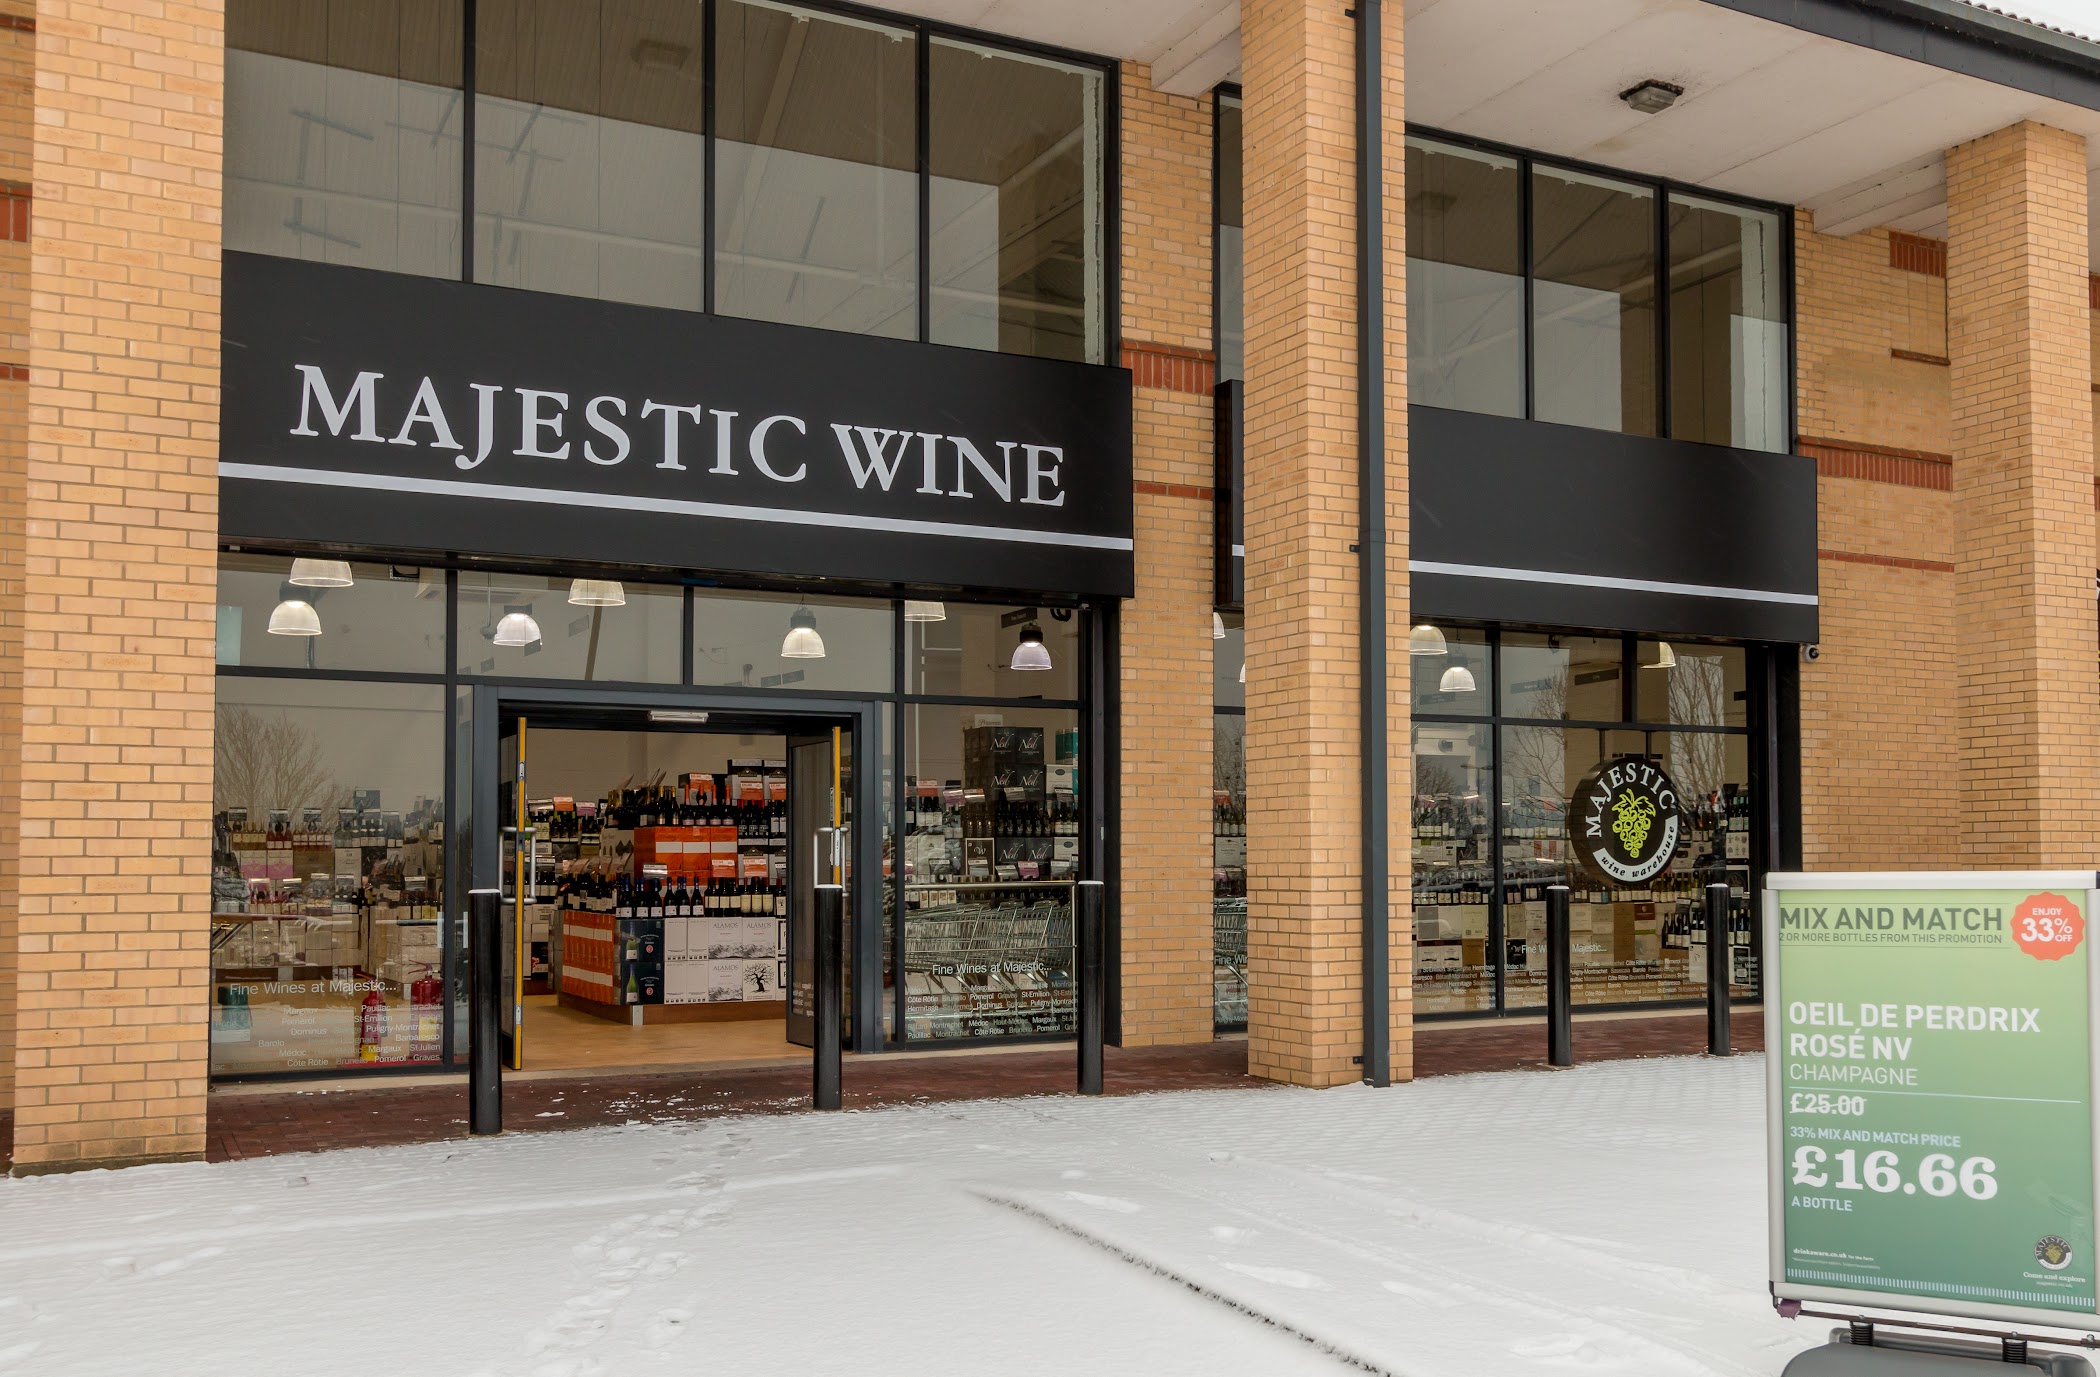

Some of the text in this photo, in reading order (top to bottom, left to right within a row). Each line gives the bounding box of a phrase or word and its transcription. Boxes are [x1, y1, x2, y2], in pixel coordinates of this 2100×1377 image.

[290, 364, 1065, 506] MAJESTIC WINE
[1585, 762, 1676, 838] MAJESTIC
[1601, 825, 1676, 878] wine warehouse
[2031, 907, 2063, 916] ENJOY
[1780, 907, 2002, 931] MIX AND MATCH
[2020, 917, 2073, 942] 33%
[1786, 932, 1800, 942] OR
[1801, 932, 1831, 942] MORE
[1832, 932, 1878, 943] BOTTLES
[1880, 933, 1910, 943] FROM
[1911, 933, 1936, 944] THIS
[1938, 934, 2002, 944] PROMOTION
[2054, 934, 2073, 942] OFF
[1521, 944, 1537, 954] Fine
[1214, 955, 1232, 965] Fine
[932, 961, 1052, 975] Fine Wines at Majestic...
[230, 979, 398, 996] Fine Wines at Majestic...
[907, 995, 922, 1003] Côte
[361, 1004, 391, 1013] Pauillac
[281, 1016, 316, 1025] Pomerol
[354, 1014, 393, 1023] St-Emilion
[968, 1019, 989, 1027] Médoc
[1789, 1001, 2041, 1033] OEIL DE PERDRIX
[291, 1023, 440, 1037] Dominus Puligny-Montrachet
[974, 1028, 988, 1036] Côte
[1036, 1023, 1061, 1032] Pomerol
[258, 1034, 441, 1048] Barolo Barbaresco
[1790, 1027, 1913, 1061] ROSÉ NV
[279, 1049, 307, 1058] Médoc
[368, 1046, 402, 1055] Margaux
[287, 1059, 306, 1068] Côte
[374, 1055, 408, 1064] Pomerol
[413, 1053, 441, 1062] Graves
[1789, 1063, 1919, 1086] CHAMPAGNE
[1789, 1092, 1867, 1117] £25.00
[1790, 1126, 1961, 1148] 33% MIX AND MATCH PRICE
[1791, 1145, 1998, 1200] £16.66
[1791, 1196, 1853, 1211] A BOTTLE
[1793, 1248, 1847, 1259] drinkaware.co.uk
[2022, 1271, 2043, 1279] Come
[2059, 1275, 2086, 1283] explore
